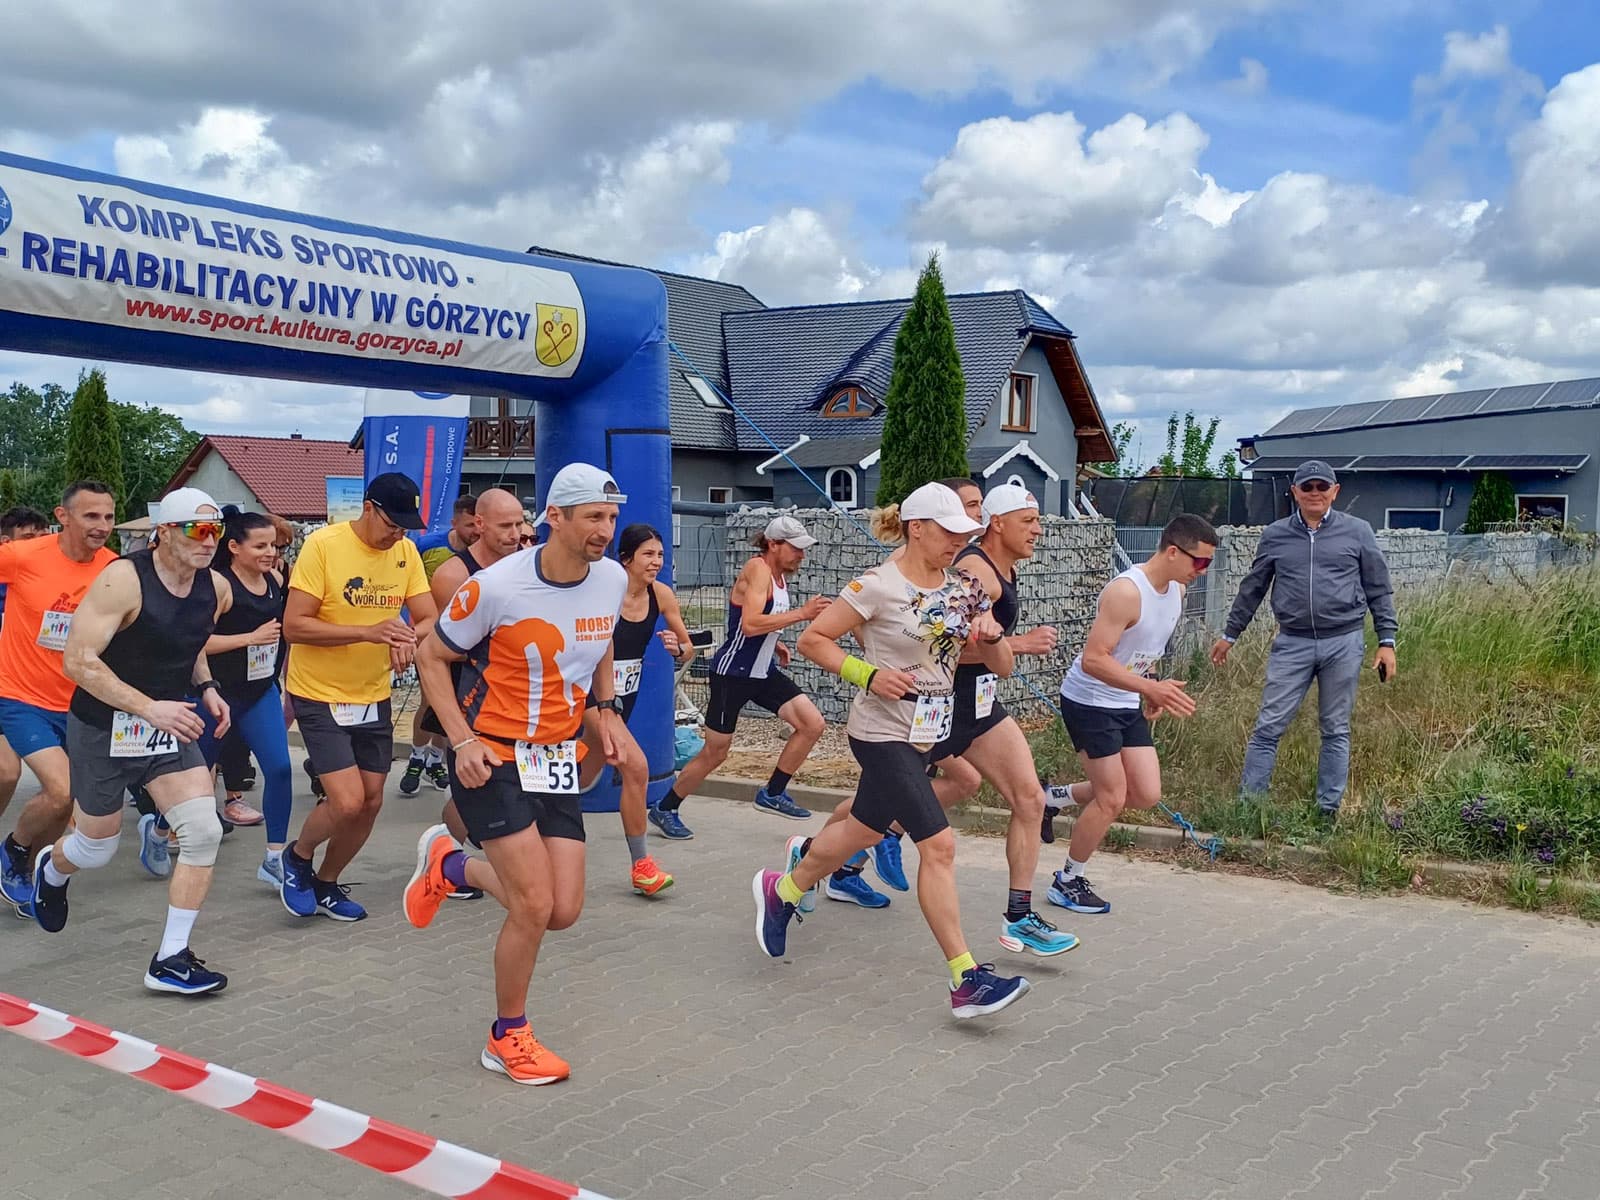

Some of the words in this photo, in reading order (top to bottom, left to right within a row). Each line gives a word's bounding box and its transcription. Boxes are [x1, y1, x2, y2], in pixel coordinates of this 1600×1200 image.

[77, 193, 284, 260] KOMPLEKS
[290, 233, 459, 288] SPORTOWO
[22, 231, 362, 320] REHABILITACYJNY
[371, 292, 397, 324] W
[406, 292, 531, 341] GÓRZYCY
[126, 299, 463, 360] www.sport.kultura.gorzyca.pl
[385, 425, 399, 465] S.A.
[355, 594, 387, 606] WORLD
[575, 614, 615, 633] MORSY
[624, 671, 640, 692] 67
[146, 728, 173, 752] 44
[548, 761, 574, 790] 53
